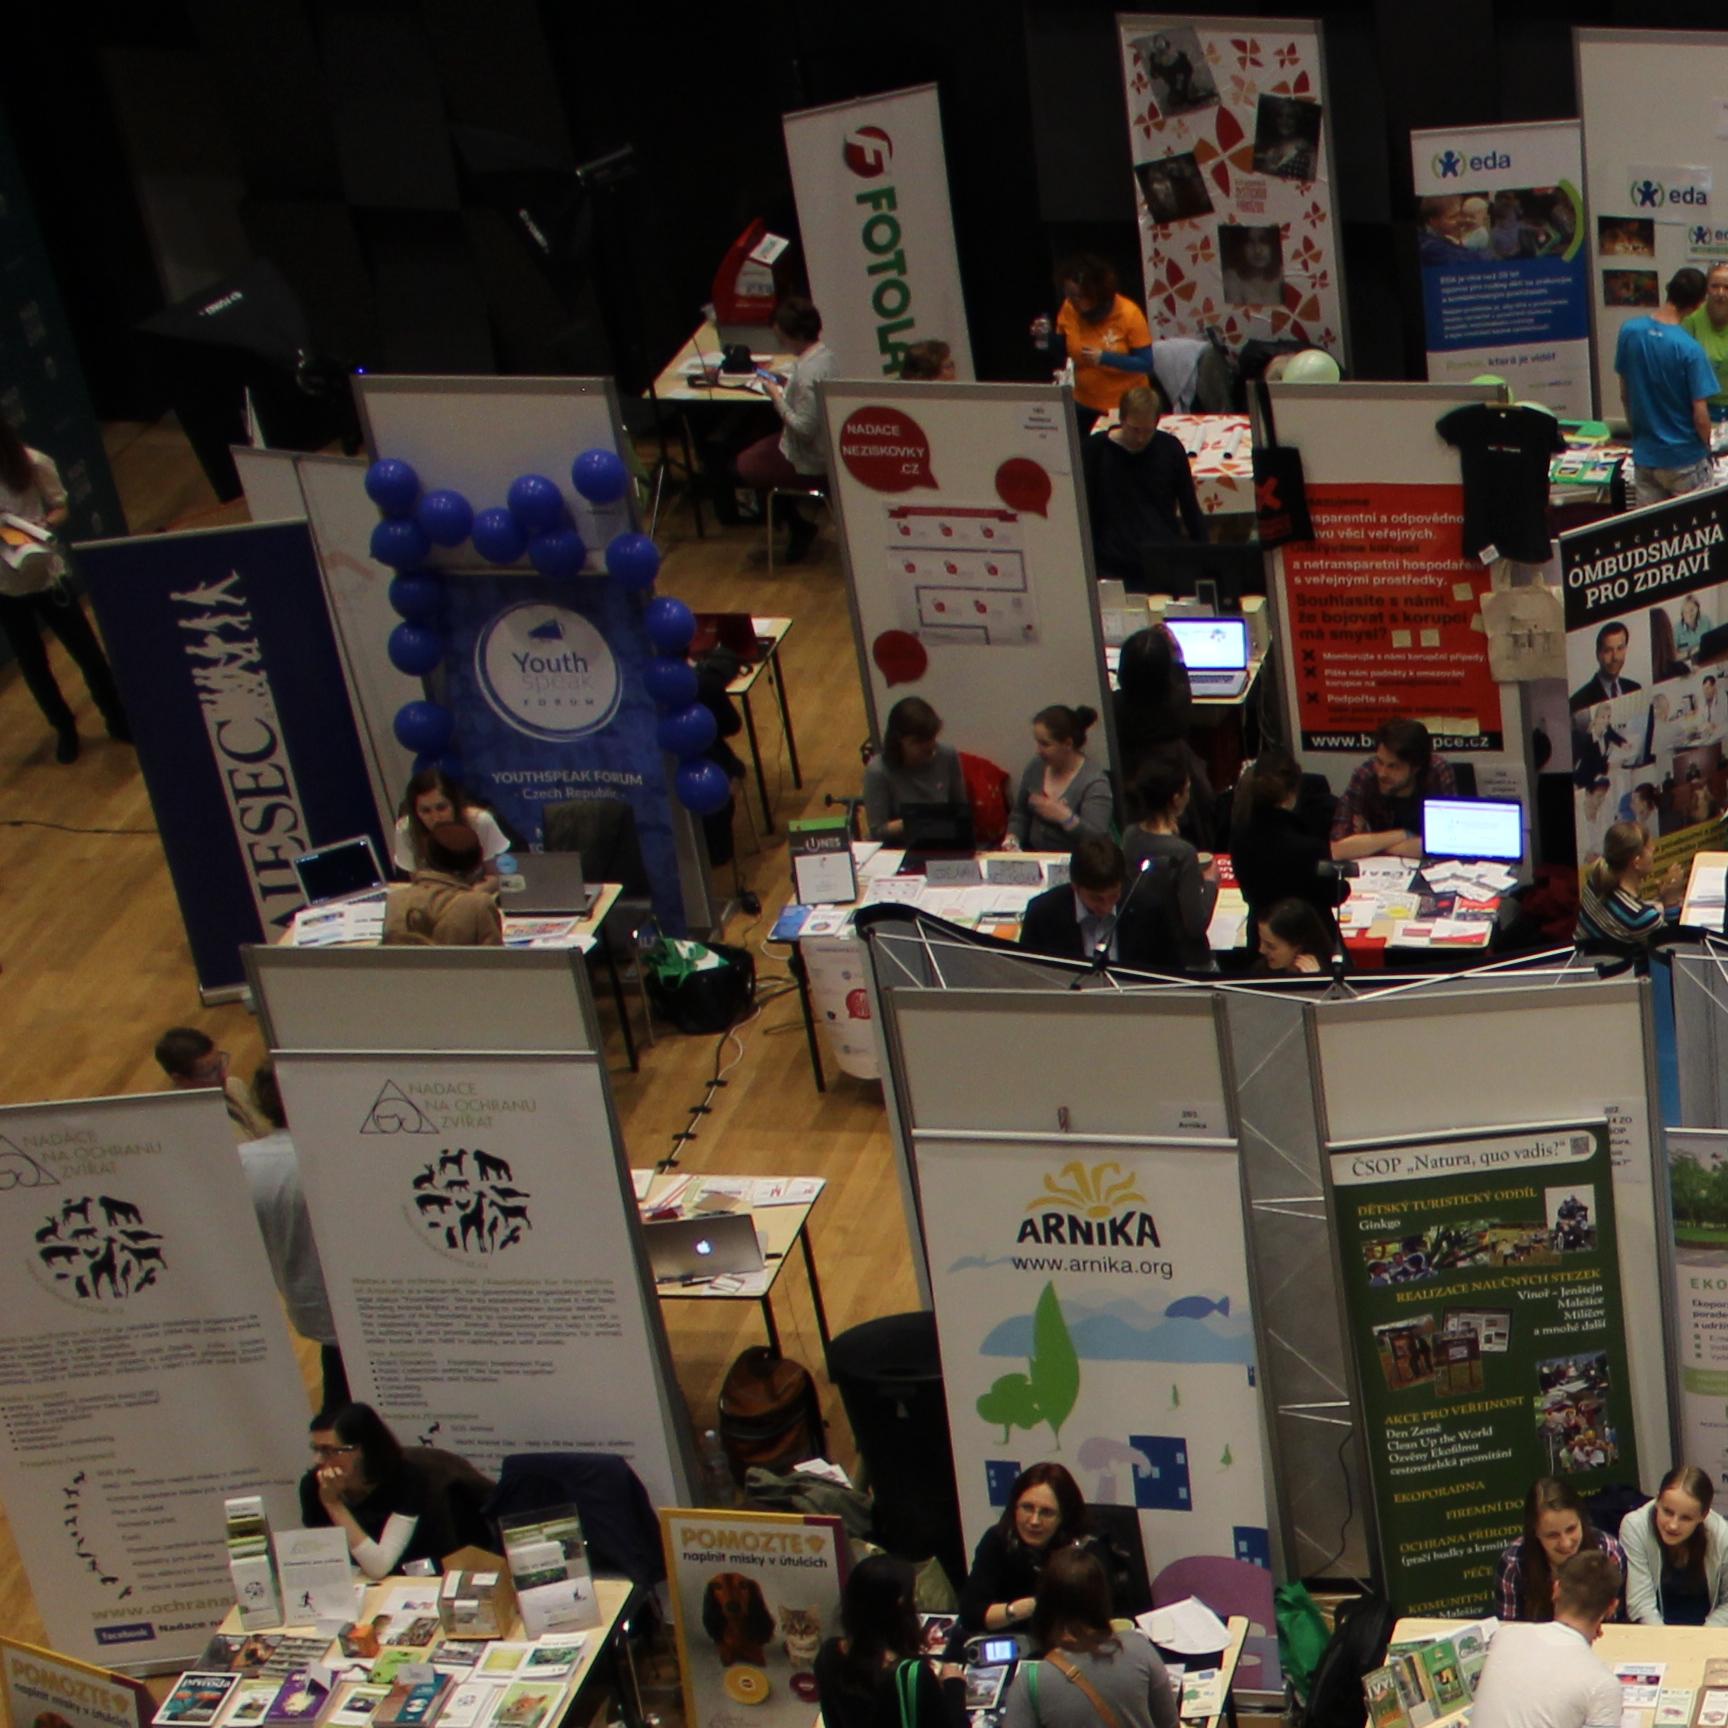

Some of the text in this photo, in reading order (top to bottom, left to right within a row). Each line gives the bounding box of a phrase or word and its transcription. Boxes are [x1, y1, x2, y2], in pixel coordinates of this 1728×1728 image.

[1469, 150, 1512, 171] eda
[1669, 184, 1708, 207] eda
[847, 423, 901, 435] NADACE
[843, 444, 924, 460] NEZISKOVKY
[1568, 525, 1724, 588] OMBUDSMANA
[1586, 553, 1710, 608] PRO ZDRAVÍ
[512, 650, 588, 678] Youth
[520, 673, 596, 695] speak
[492, 771, 643, 786] YOUTHSPEAK FORUM
[214, 714, 304, 938] AIESEC
[408, 1082, 478, 1096] NADACE
[425, 1097, 538, 1113] NA OCHRANU
[1358, 1186, 1537, 1217] DĚTSKÝ TURISTICKÝ ODDÍL
[1359, 1219, 1400, 1232] Ginkgo
[1012, 1253, 1173, 1280] www.arnika.org
[1396, 1269, 1601, 1302] REALIZACE NAUČNÝCH STEZEK
[1385, 1396, 1525, 1426] AKCE PRO VEŘEJNOST
[1394, 1480, 1485, 1502] EKOPORADNA
[679, 1529, 802, 1552] POMOZTE
[10, 1656, 113, 1710] POMOZTE
